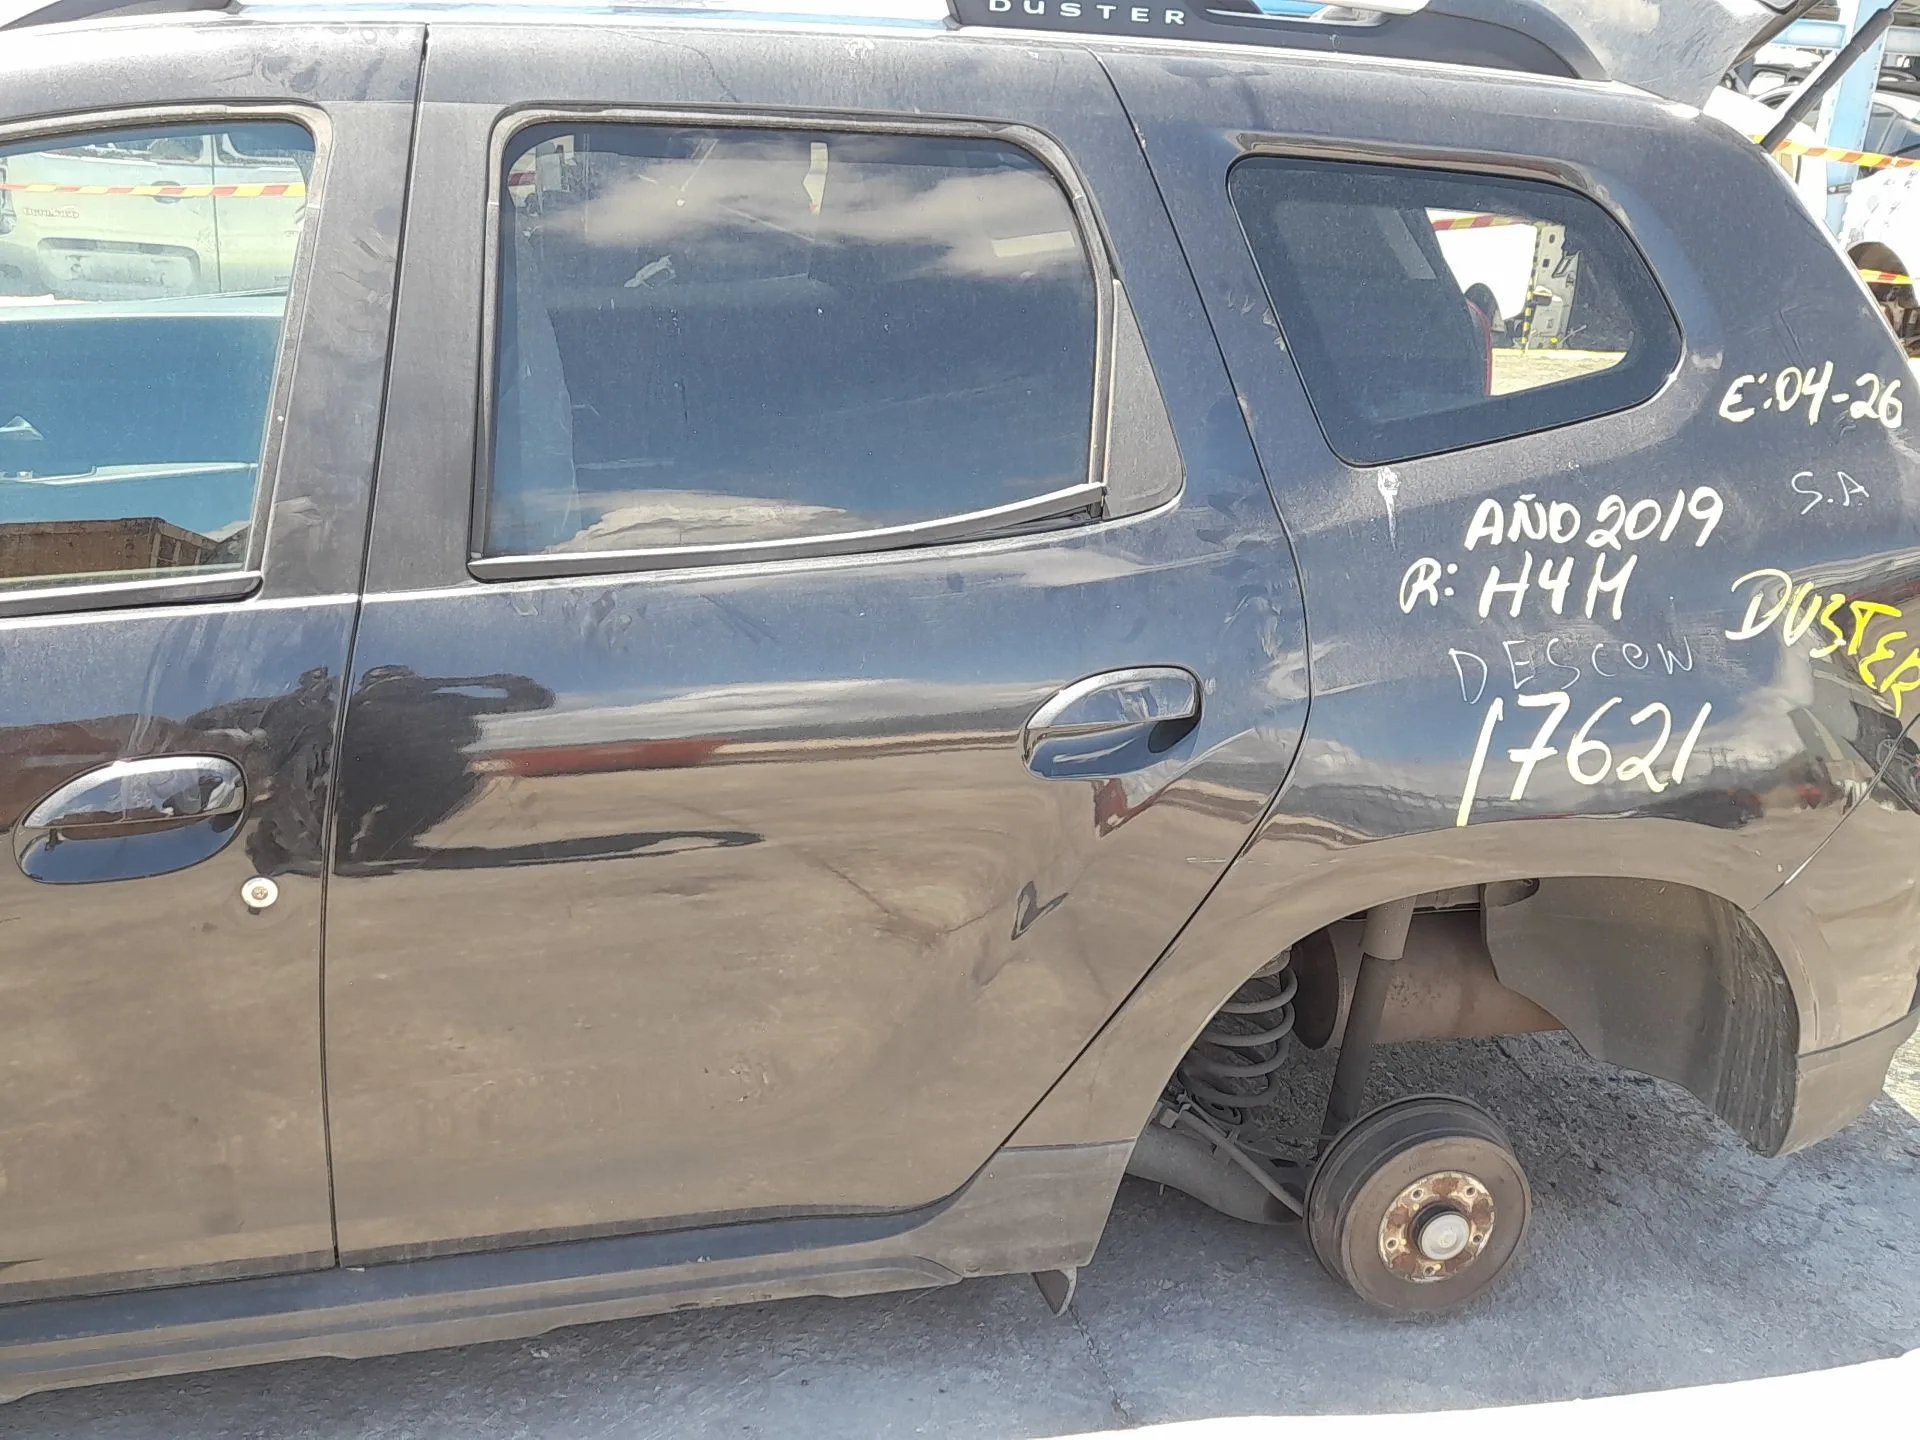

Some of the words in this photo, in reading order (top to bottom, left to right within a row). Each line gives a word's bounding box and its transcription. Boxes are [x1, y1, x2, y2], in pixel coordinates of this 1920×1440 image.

[989, 0, 1185, 25] DUSTER
[1585, 486, 1724, 550] 2019
[1725, 568, 1920, 718] DUSTER
[1456, 691, 1713, 827] 17621
